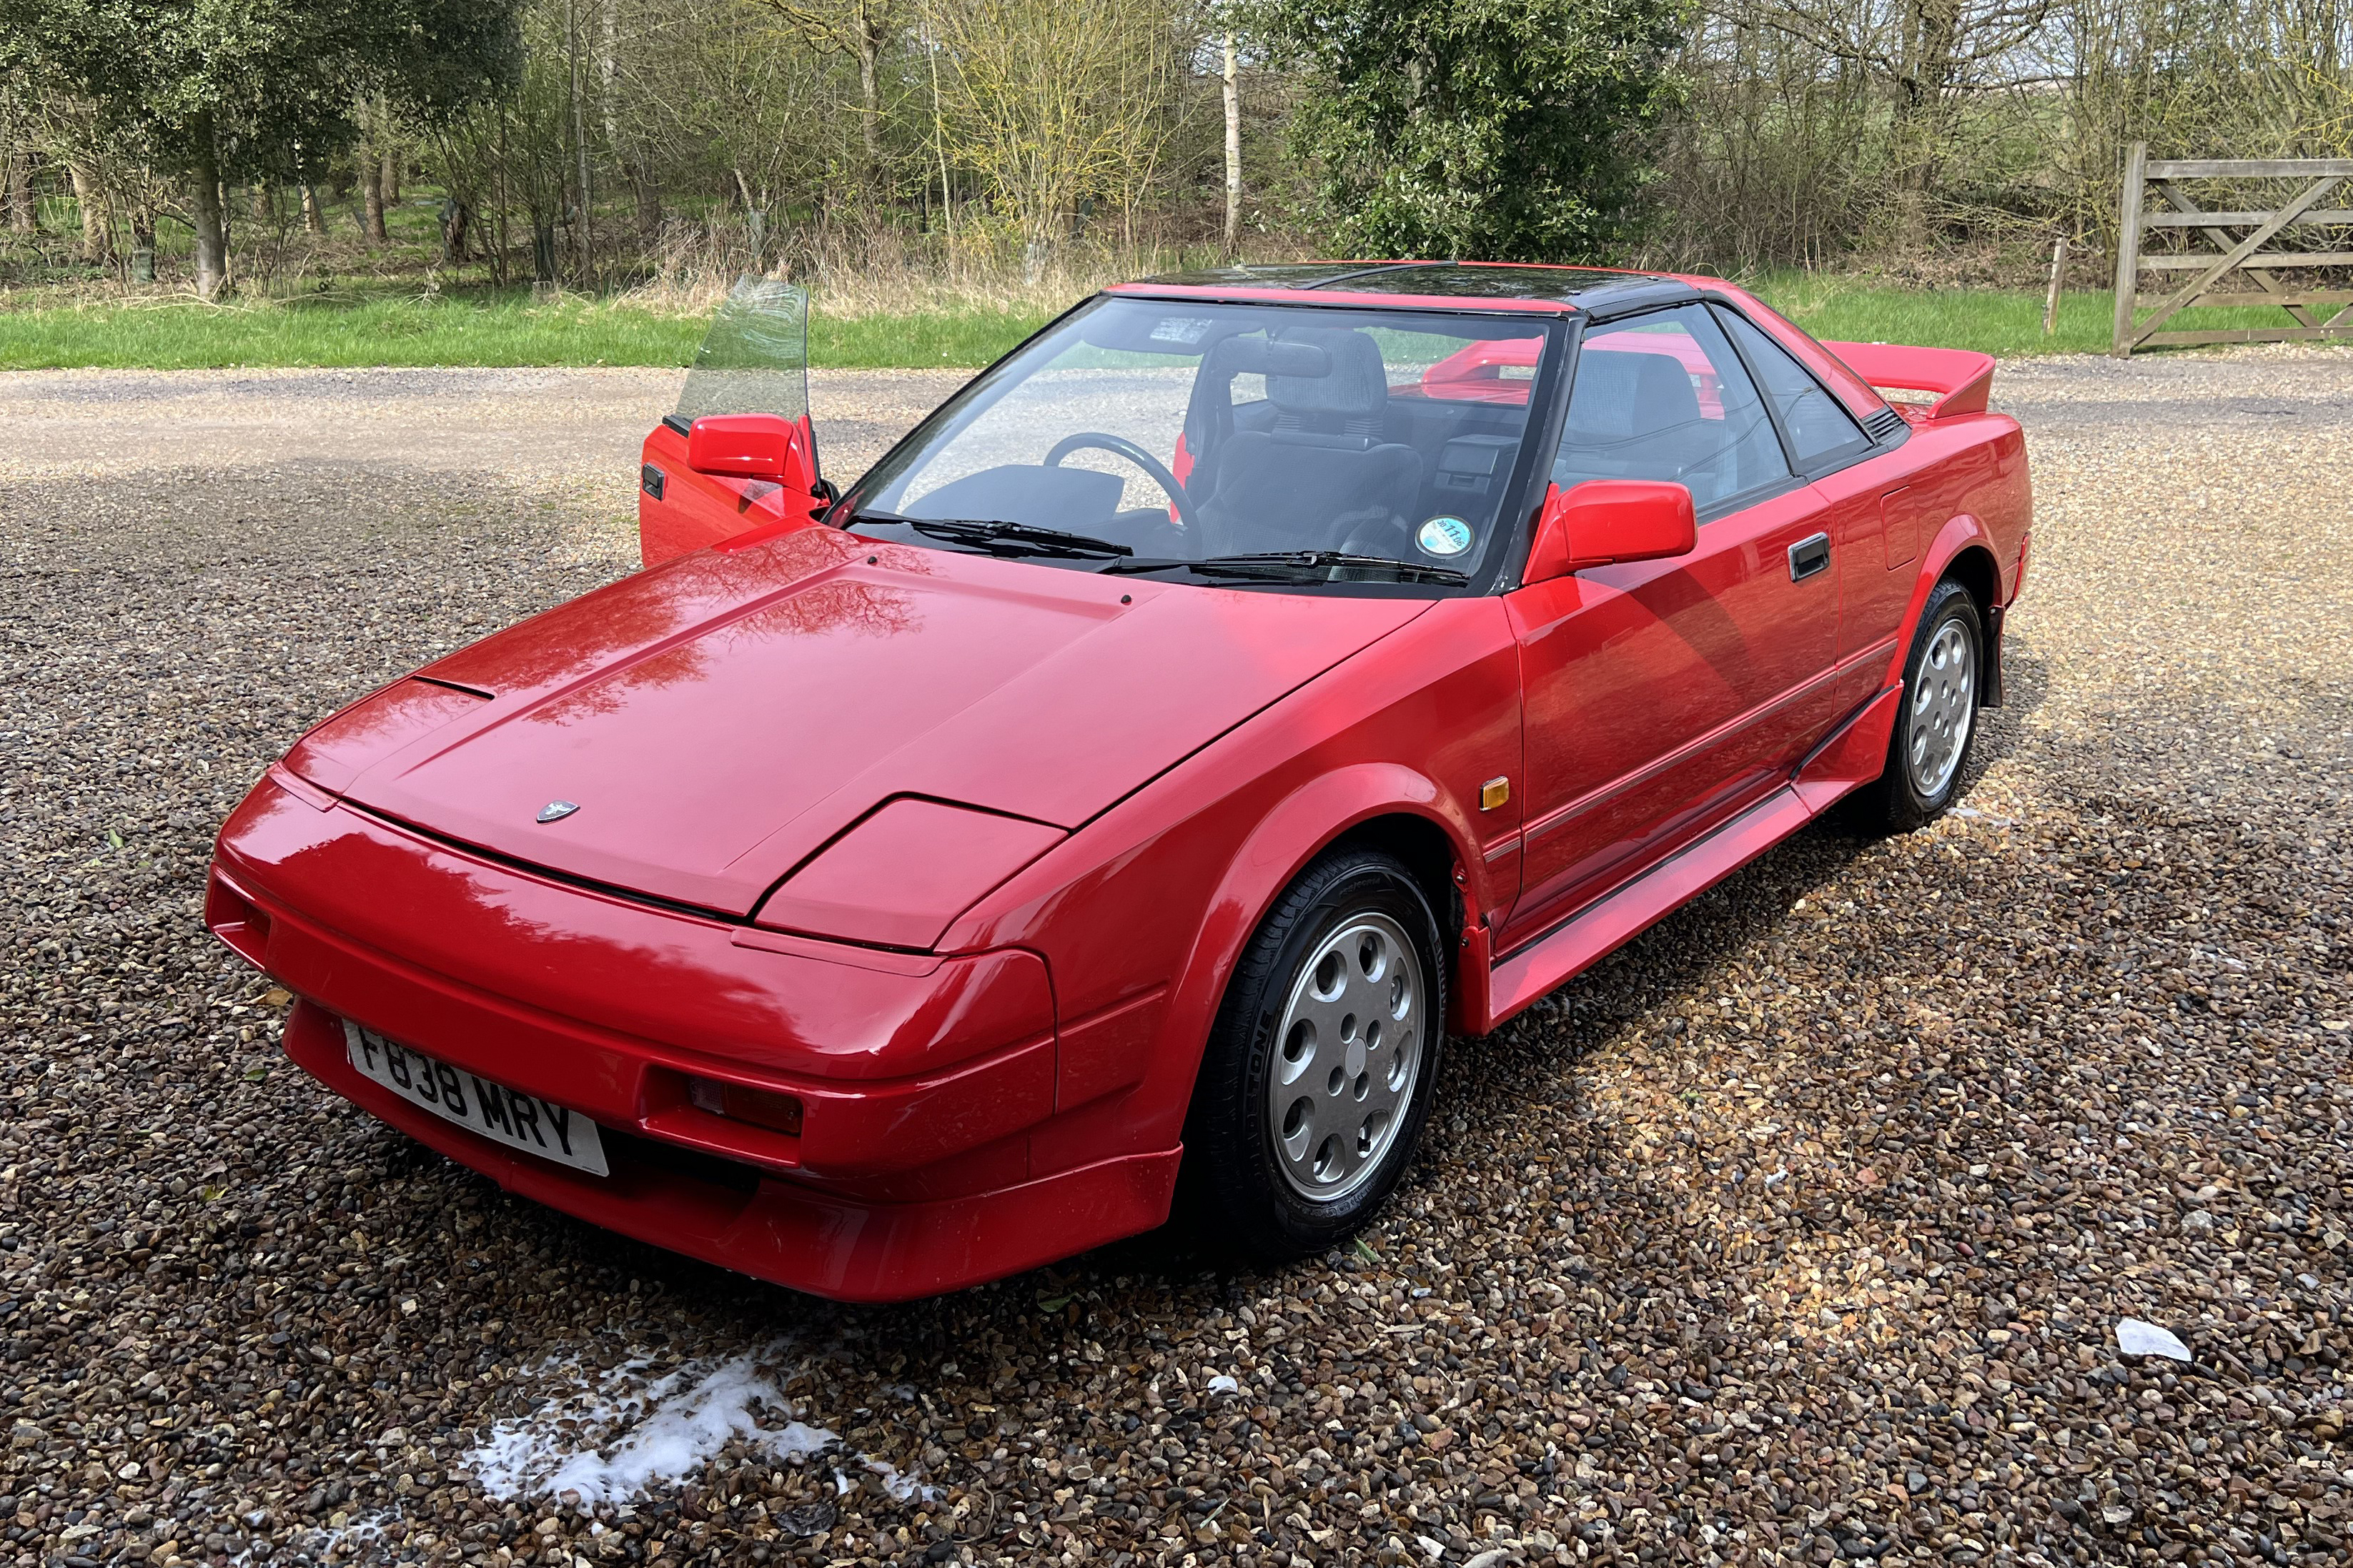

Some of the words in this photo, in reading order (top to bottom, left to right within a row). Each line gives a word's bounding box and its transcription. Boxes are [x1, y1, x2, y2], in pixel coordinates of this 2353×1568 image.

[1445, 525, 1460, 537] 11
[357, 1026, 468, 1117] F838
[470, 1075, 573, 1157] MRY
